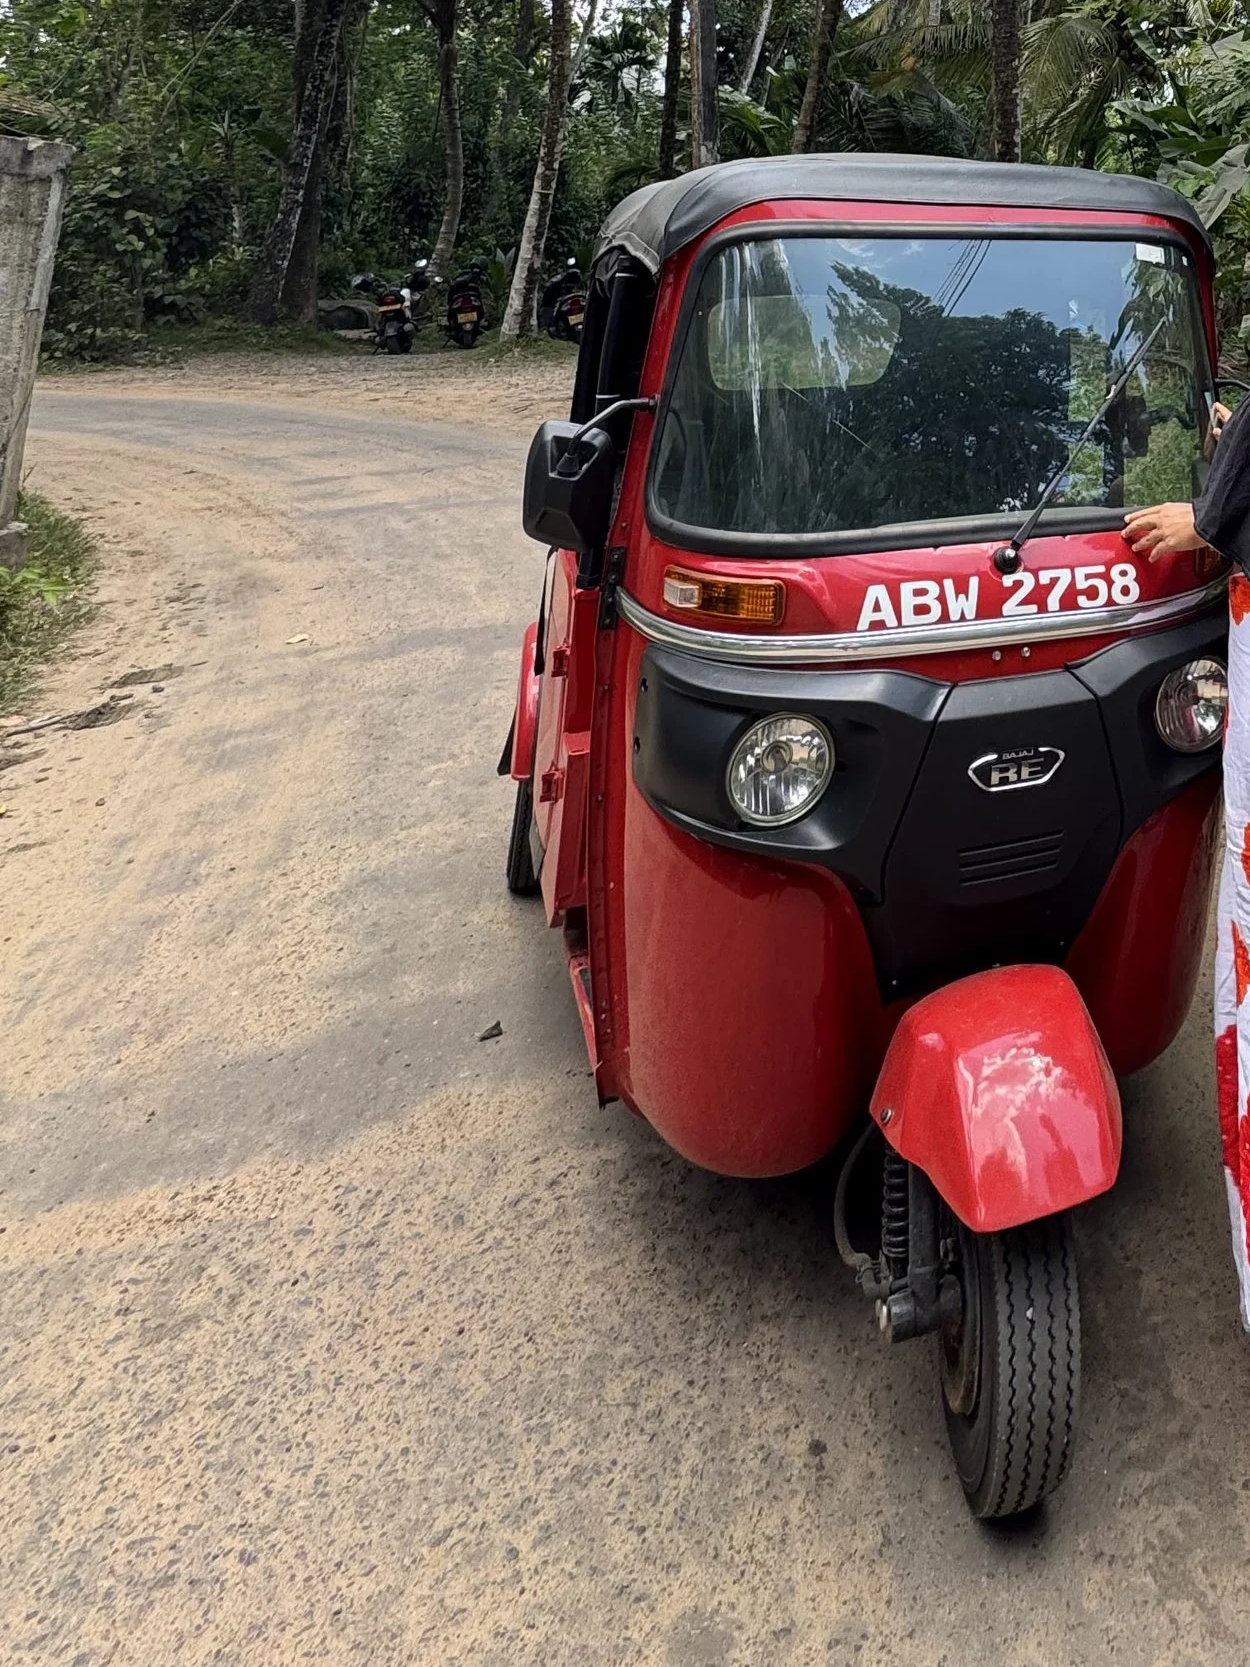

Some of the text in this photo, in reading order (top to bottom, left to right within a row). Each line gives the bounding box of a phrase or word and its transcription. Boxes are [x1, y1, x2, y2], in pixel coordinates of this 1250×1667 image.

[856, 563, 1141, 632] ABW 2758
[1002, 749, 1034, 760] BAJAJ
[990, 758, 1044, 786] RE
